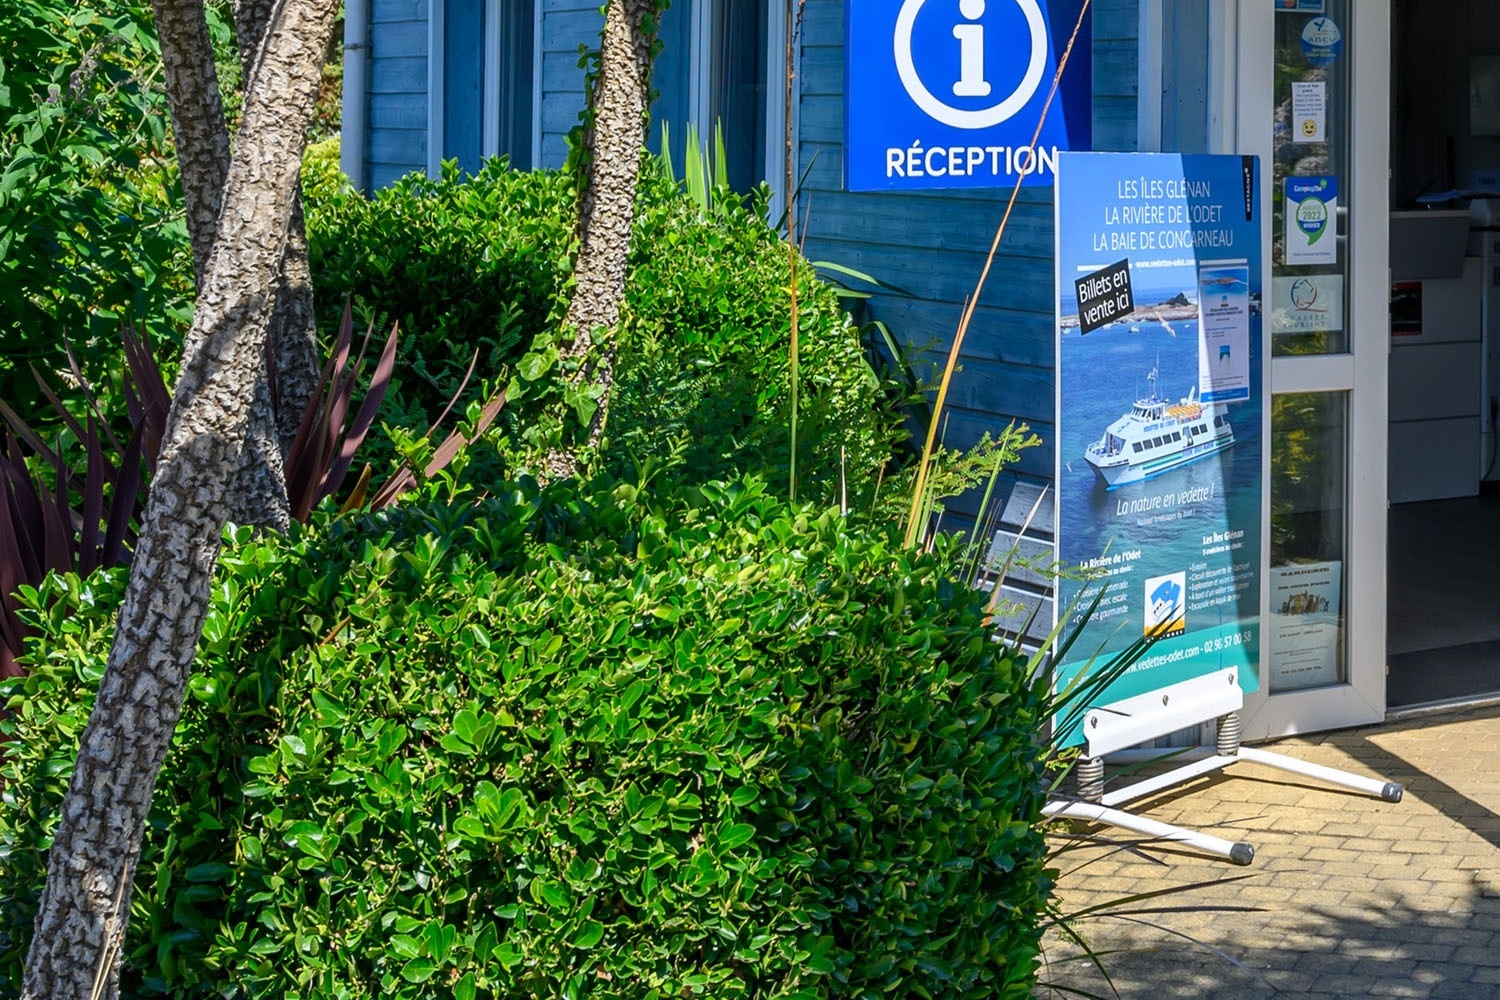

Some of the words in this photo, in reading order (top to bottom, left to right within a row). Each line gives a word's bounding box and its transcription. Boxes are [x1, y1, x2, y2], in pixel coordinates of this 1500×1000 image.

[886, 139, 1058, 178] RÉCEPTION
[1118, 180, 1138, 199] LES
[1141, 176, 1163, 199] ÎLES
[1166, 176, 1211, 199] GLÉNAN
[1105, 207, 1120, 225] LA
[1123, 203, 1165, 224] RIVIÈRE
[1168, 206, 1183, 223] DE
[1185, 205, 1223, 223] L'ODET
[1302, 211, 1322, 220] 2022
[1093, 233, 1108, 251] LA
[1111, 232, 1137, 250] BAIE
[1140, 231, 1155, 249] DE
[1158, 229, 1233, 249] CONCARNEAU
[1079, 275, 1112, 303] Billets
[1113, 269, 1128, 288] en
[1084, 299, 1115, 325] vente
[1116, 289, 1129, 311] ici
[1116, 499, 1128, 516] La
[1130, 495, 1161, 513] nature
[1163, 492, 1175, 508] en
[1177, 485, 1208, 505] vedette
[1202, 535, 1213, 546] Les
[1224, 530, 1244, 541] Glénan
[1089, 556, 1112, 568] Rivière
[1113, 553, 1121, 564] de
[1122, 549, 1142, 562] l'Odet
[1204, 640, 1213, 654] 02
[1224, 635, 1232, 648] 57
[1233, 633, 1242, 646] 00
